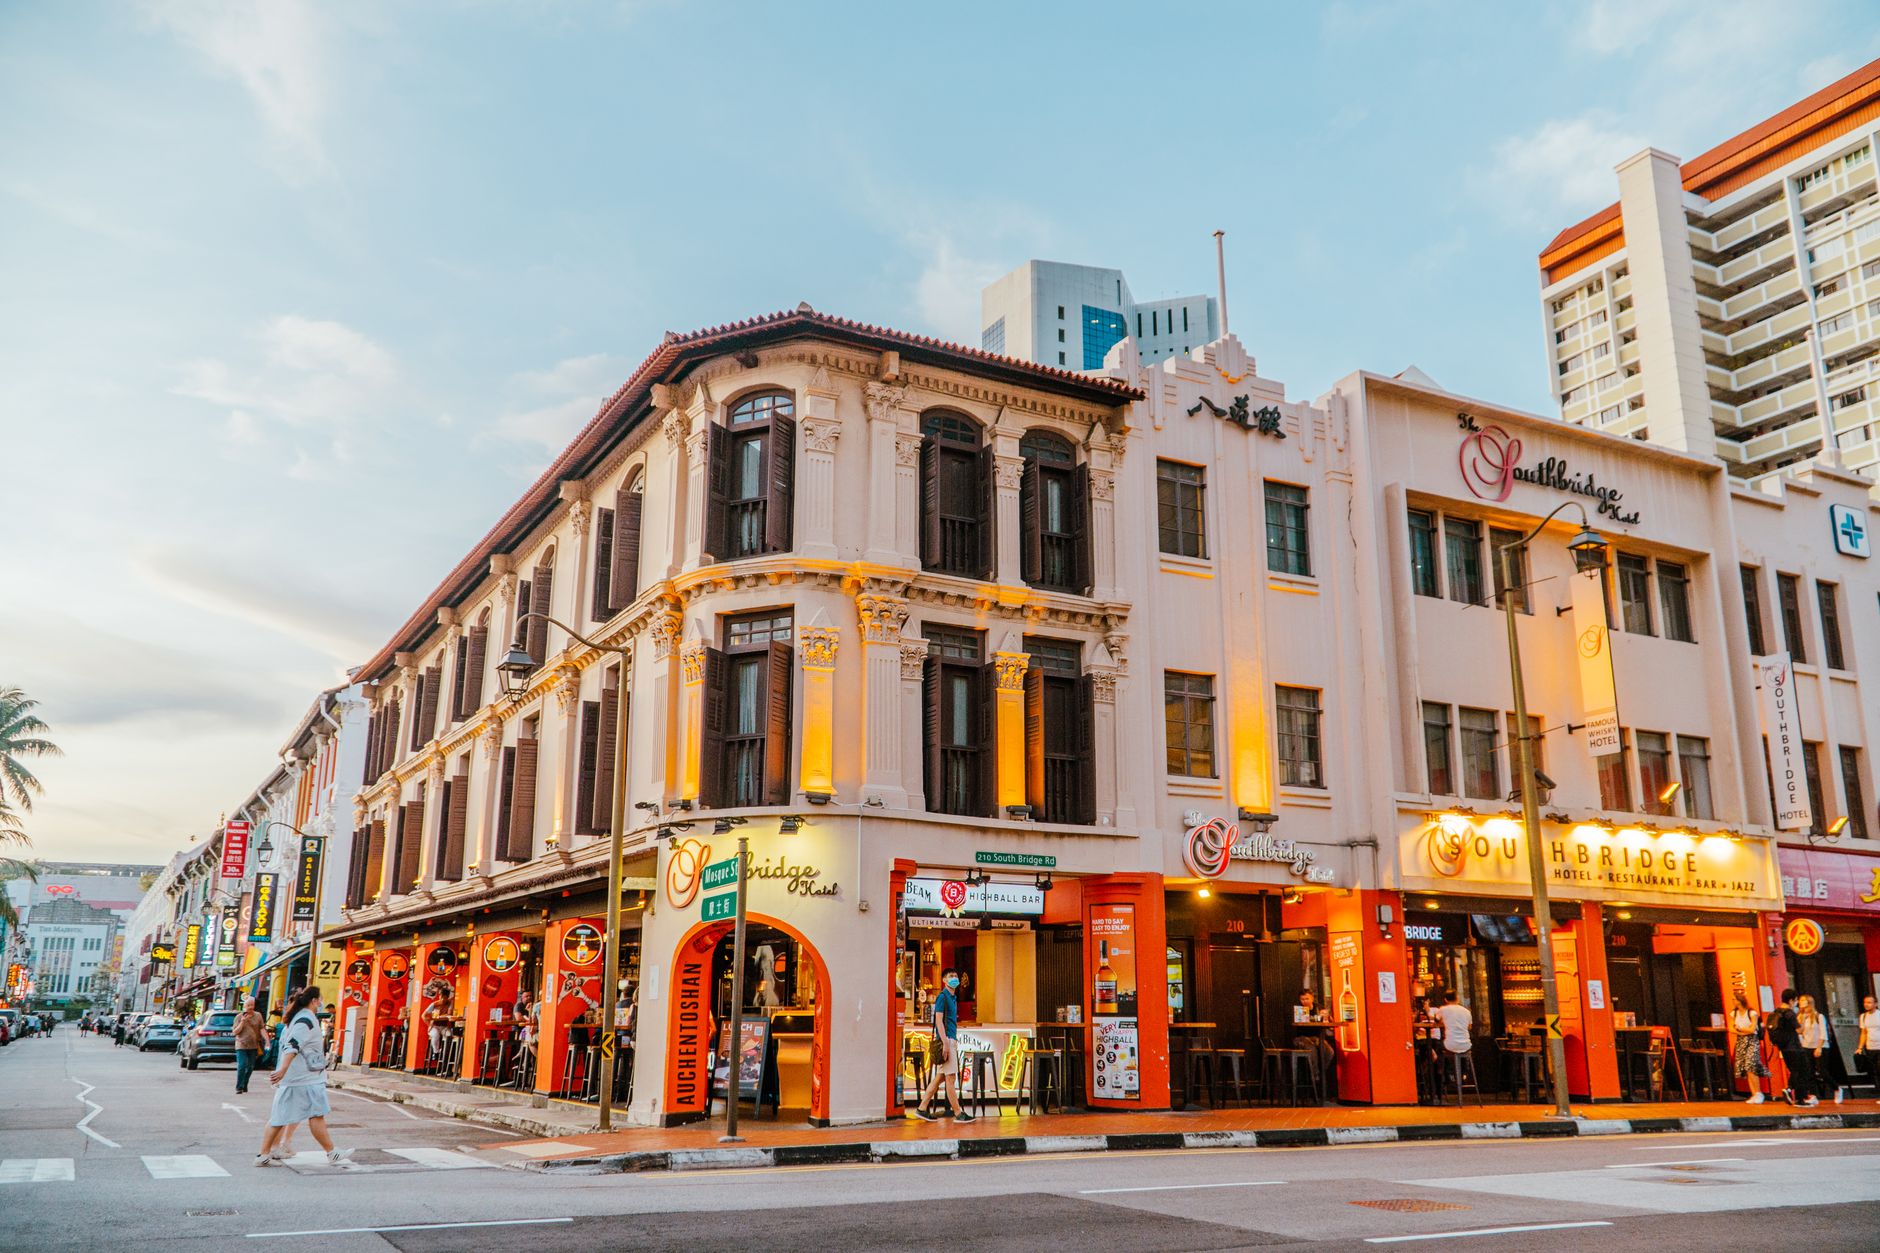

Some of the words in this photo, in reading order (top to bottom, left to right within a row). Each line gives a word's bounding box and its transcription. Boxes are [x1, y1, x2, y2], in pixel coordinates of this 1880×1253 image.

[1460, 424, 1623, 514] Southbridge
[1587, 717, 1616, 729] FAMOUS
[1588, 726, 1617, 738] WHISKY
[1589, 736, 1617, 747] HOTEL
[1775, 676, 1797, 804] SOUTHBRIDGE
[1780, 809, 1809, 821] HOTEL
[1188, 817, 1316, 877] Southbridge
[1450, 834, 1697, 873] SOUHBRIDGE
[977, 853, 992, 862] 210
[993, 854, 1016, 863] South
[1018, 855, 1043, 866] Bridge
[1045, 856, 1056, 865] Rd
[303, 857, 313, 894] GALAXY
[666, 839, 820, 909] Sbridge
[705, 866, 729, 885] Mosque
[730, 861, 738, 878] St
[1554, 869, 1592, 881] HOTEL
[1608, 872, 1681, 886] RESTAURANT
[1696, 876, 1718, 889] BAR
[1731, 881, 1756, 892] JAZZ
[800, 880, 839, 897] Hotel
[970, 892, 1018, 903] HIGHBALL
[1022, 895, 1041, 904] BAR
[256, 885, 270, 928] GALAXY
[911, 919, 949, 927] ULTIMATE
[1226, 920, 1244, 932] 210
[253, 927, 268, 936] 28
[1404, 925, 1443, 940] BRIDGE
[320, 960, 342, 975] 27
[676, 963, 703, 1106] AUCHENTOSHAN
[723, 1023, 753, 1031] LCH
[1100, 1021, 1117, 1036] VERY
[1096, 1035, 1133, 1043] HIGHBALL
